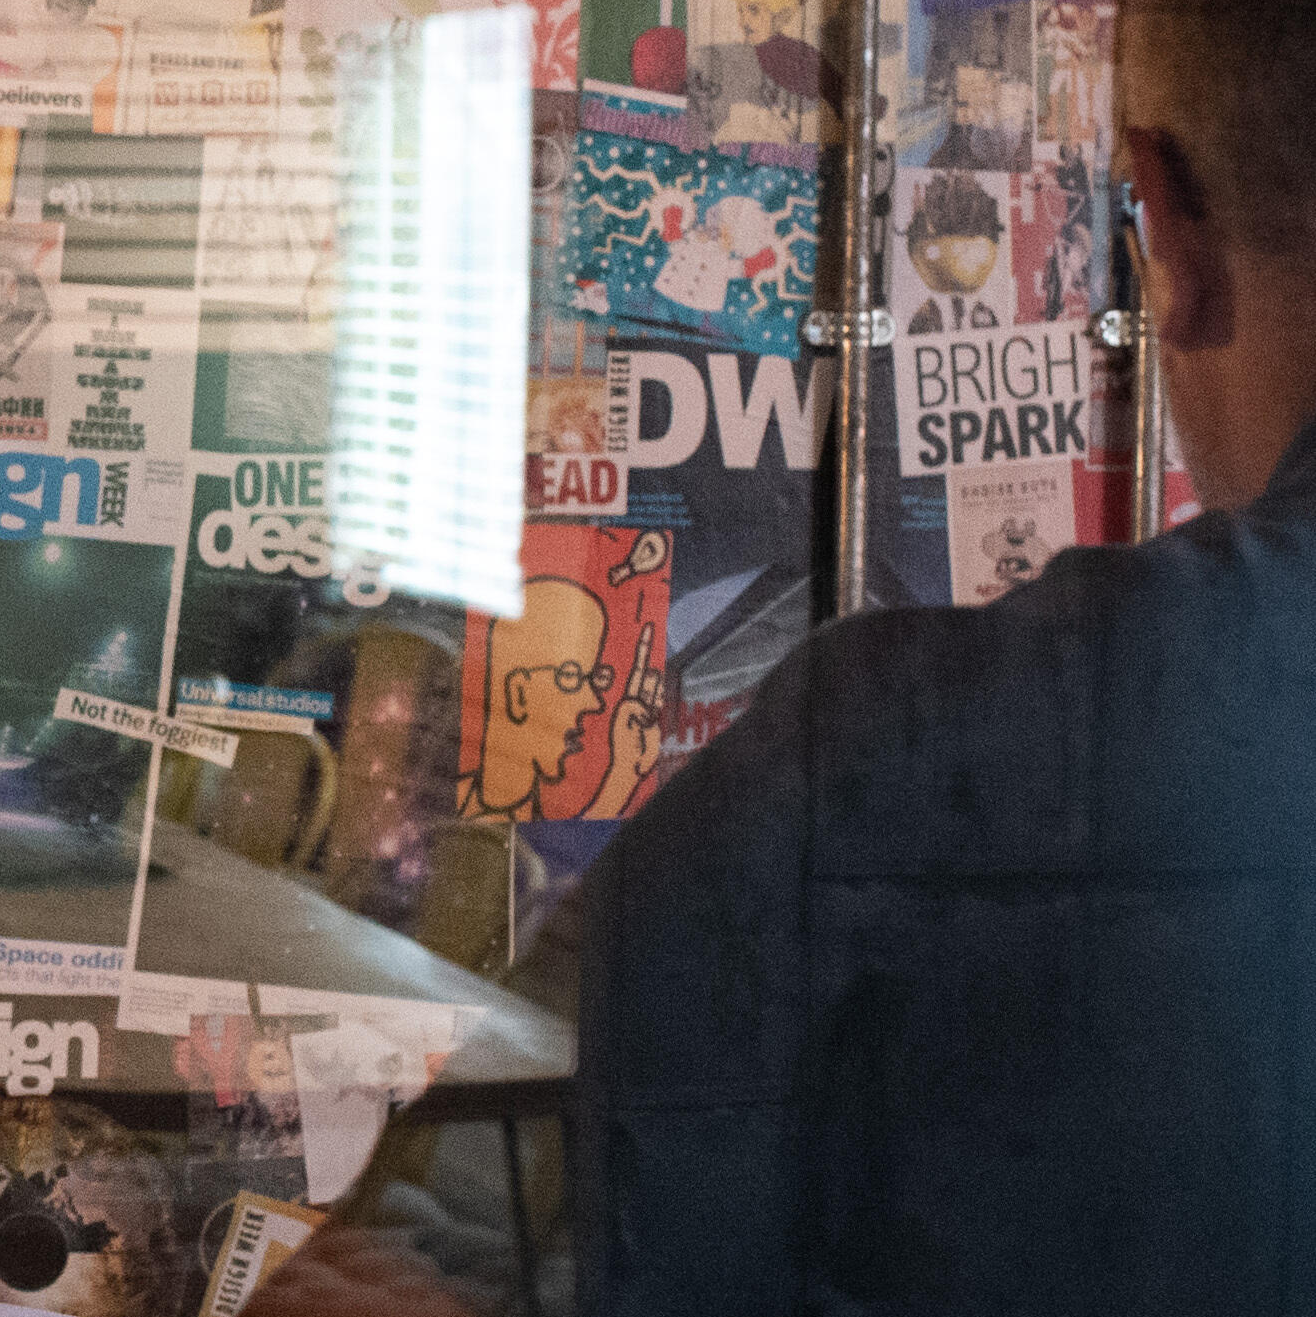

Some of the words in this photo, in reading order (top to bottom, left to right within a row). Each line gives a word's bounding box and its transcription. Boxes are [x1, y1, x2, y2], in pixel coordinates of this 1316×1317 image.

[632, 351, 841, 471] DW
[917, 400, 1086, 468] SPARK
[100, 458, 131, 529] WEEK
[234, 460, 324, 508] ONE
[71, 695, 108, 719] Not
[112, 706, 145, 730] the
[150, 717, 229, 754] foggiest
[264, 690, 332, 715] studios
[215, 1256, 251, 1315] DESIGN
[236, 1211, 266, 1253] WEEK
